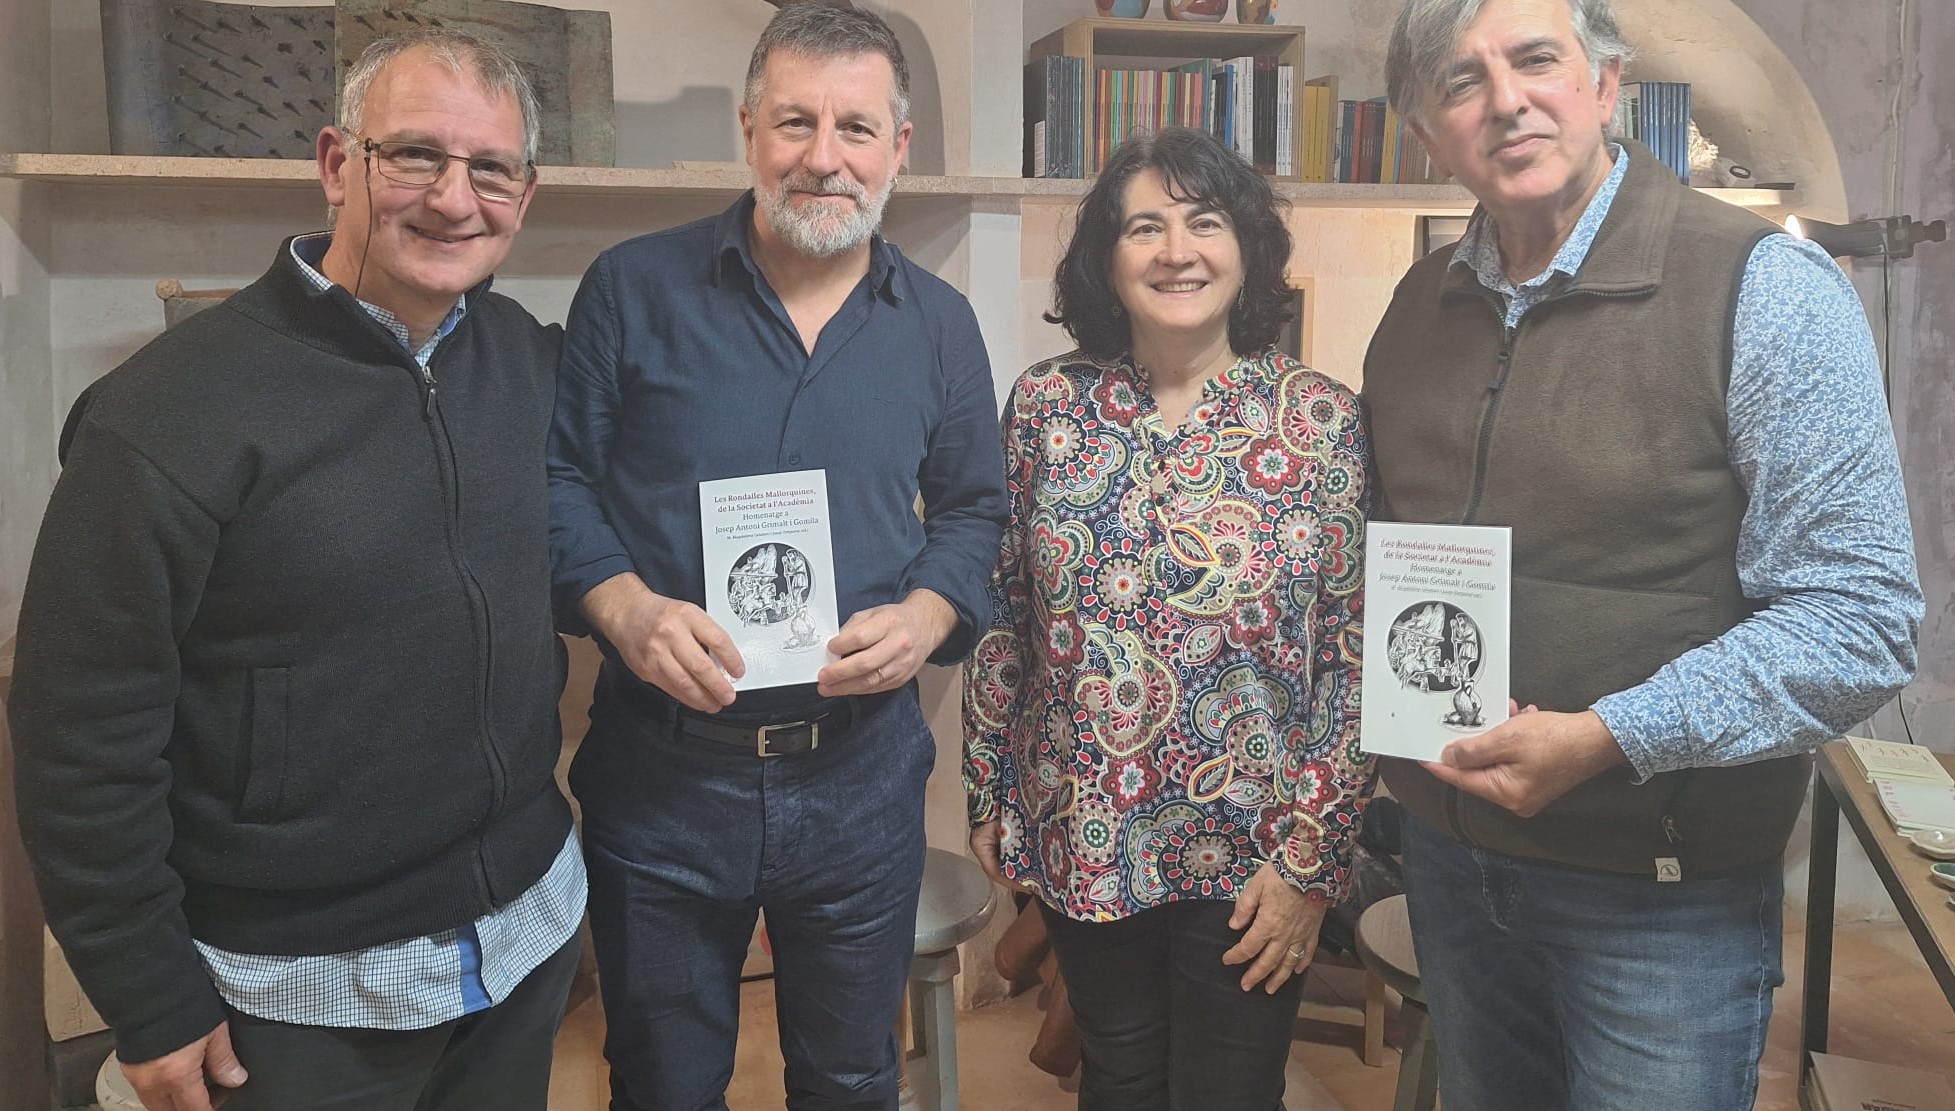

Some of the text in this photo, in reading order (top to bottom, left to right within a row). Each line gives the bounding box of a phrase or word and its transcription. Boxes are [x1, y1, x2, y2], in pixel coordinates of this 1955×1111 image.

[714, 488, 816, 504] Les Rondalles Mallorquines,
[718, 505, 726, 513] de
[736, 502, 766, 511] Societat
[742, 510, 784, 520] Homenatge
[715, 526, 734, 534] Josep
[736, 522, 760, 531] Antoni
[761, 519, 788, 529] Grimalt
[793, 517, 819, 526] Gomila
[1380, 538, 1394, 548] Les
[1396, 540, 1436, 551] Rondalles
[1383, 550, 1394, 559] de
[1395, 550, 1403, 559] la
[1404, 551, 1438, 562] Societat
[1410, 563, 1456, 576] Homenatge
[1379, 572, 1400, 583] Josep
[1401, 574, 1428, 584] Antoni
[1430, 576, 1461, 586] Grimalt
[1466, 580, 1496, 591] Gomila
